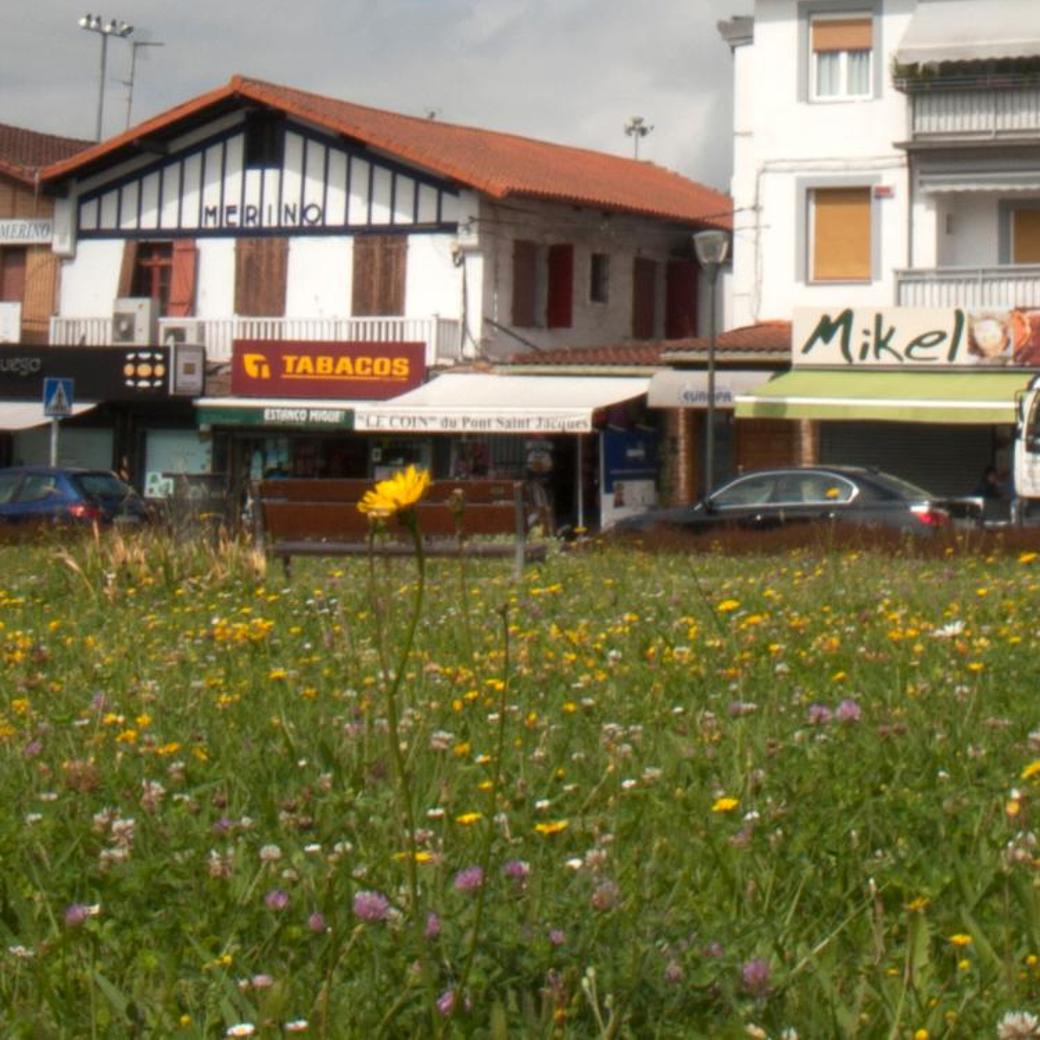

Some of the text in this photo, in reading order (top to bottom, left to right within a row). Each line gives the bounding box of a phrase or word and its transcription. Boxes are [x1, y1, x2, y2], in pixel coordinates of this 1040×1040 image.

[204, 203, 322, 225] MERINO
[801, 308, 965, 364] Mikel
[282, 355, 410, 376] TABACOS
[441, 416, 457, 428] du
[496, 416, 530, 429] Saint
